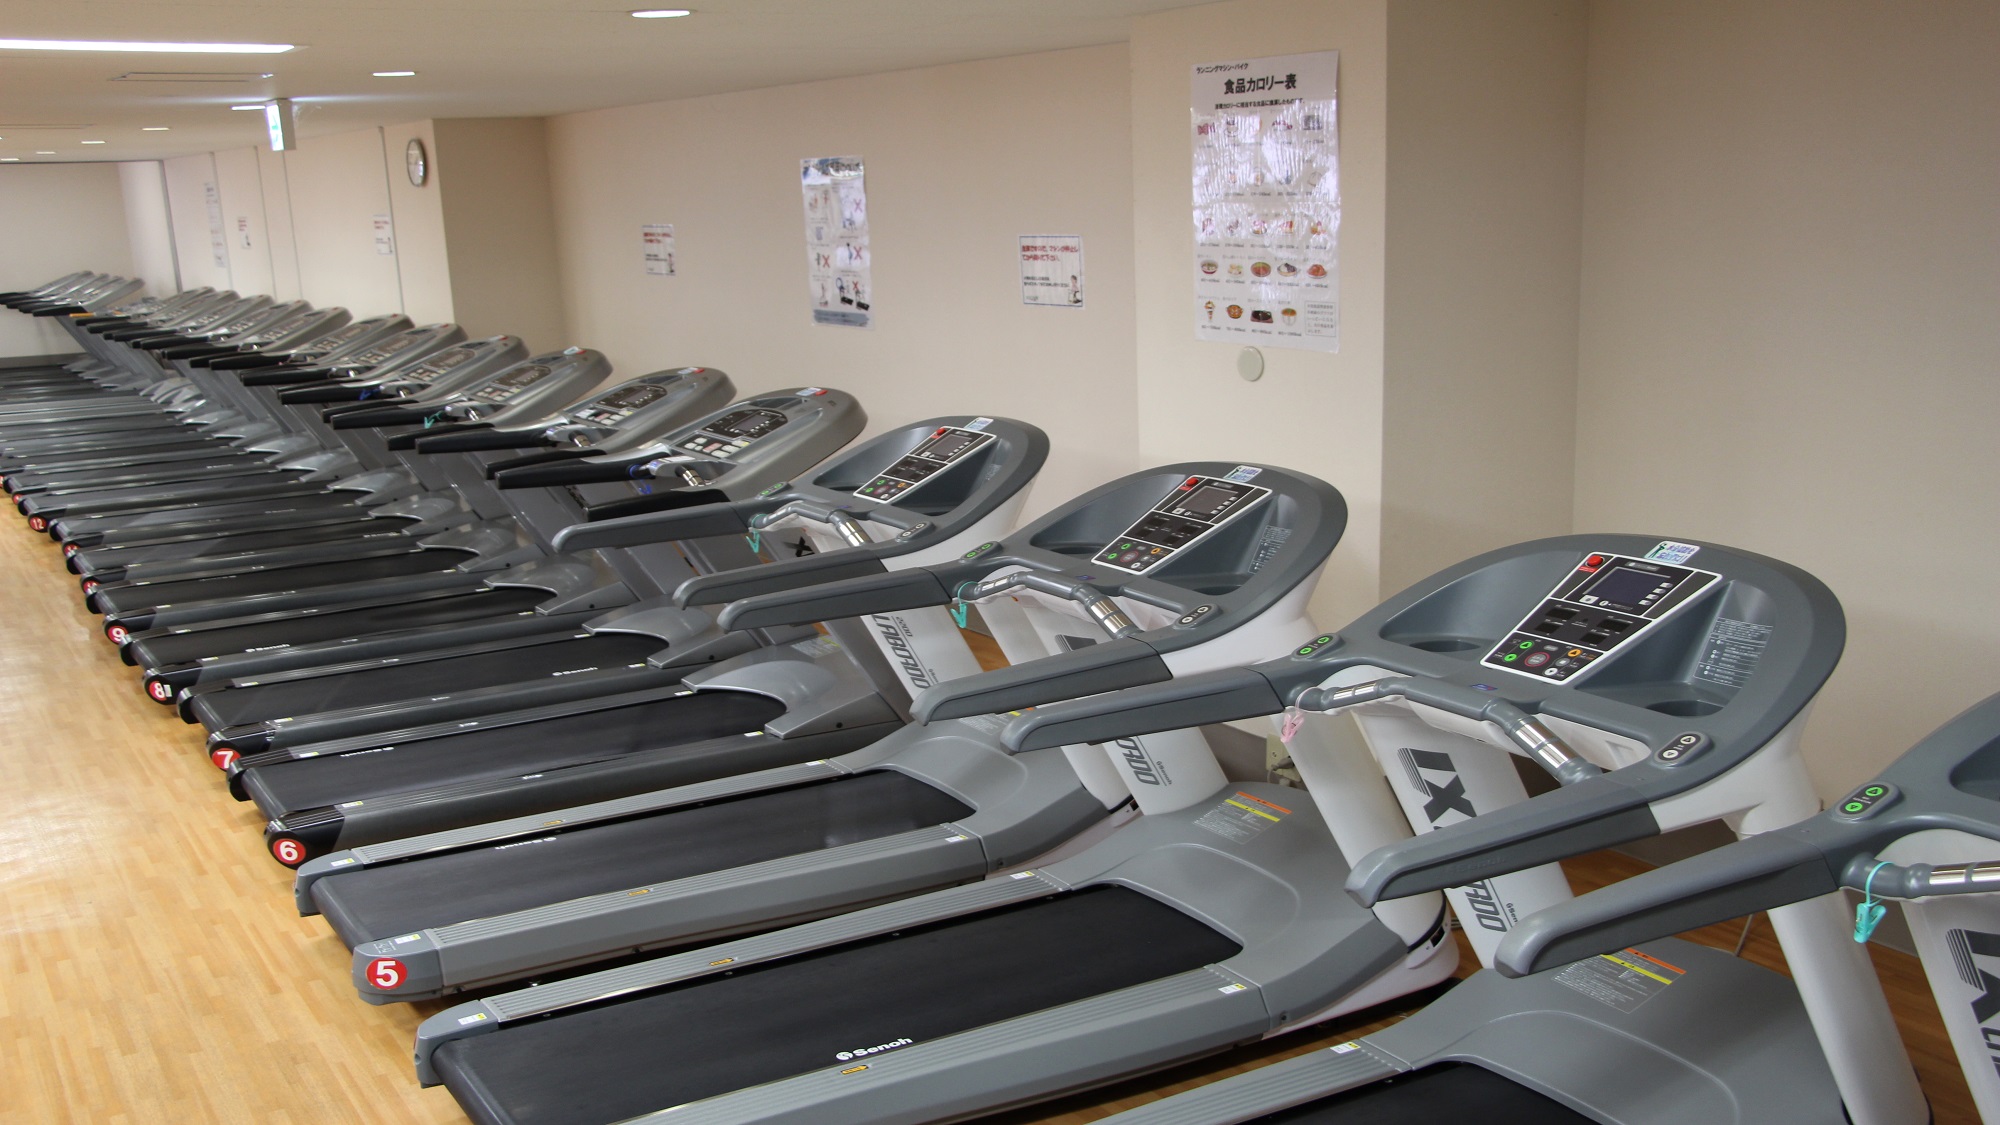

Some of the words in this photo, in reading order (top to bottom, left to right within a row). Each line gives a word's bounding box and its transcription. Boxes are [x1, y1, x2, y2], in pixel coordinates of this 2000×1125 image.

[1223, 73, 1297, 95] 食品カロリー表
[32, 517, 45, 530] 12
[112, 627, 125, 641] 9
[154, 682, 166, 699] 8
[217, 750, 234, 769] 7
[279, 841, 299, 862] 6
[375, 960, 399, 987] 5
[852, 1038, 914, 1057] Senoh
